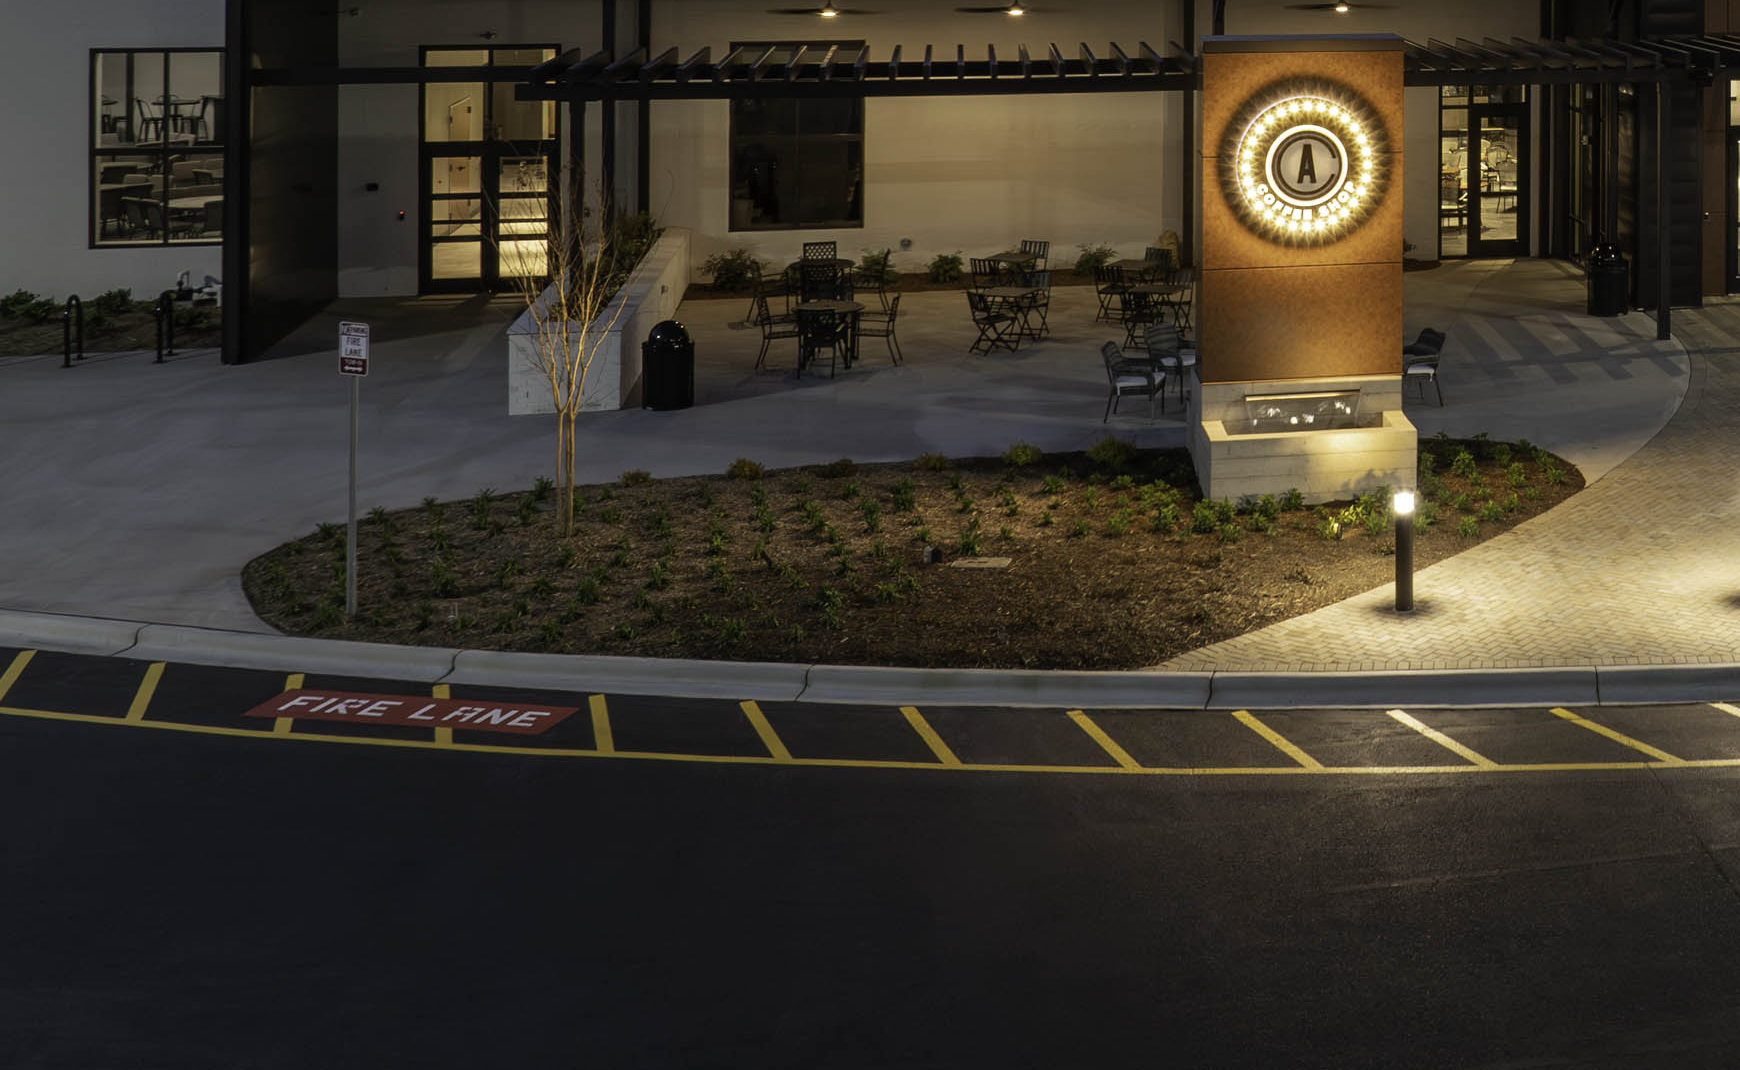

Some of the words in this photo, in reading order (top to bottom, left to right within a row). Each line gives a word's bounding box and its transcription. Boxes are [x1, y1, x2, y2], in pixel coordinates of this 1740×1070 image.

[1256, 183, 1313, 220] COFFEE
[1318, 180, 1355, 217] SHOP
[277, 695, 403, 718] FIRE
[407, 703, 551, 727] LANE
